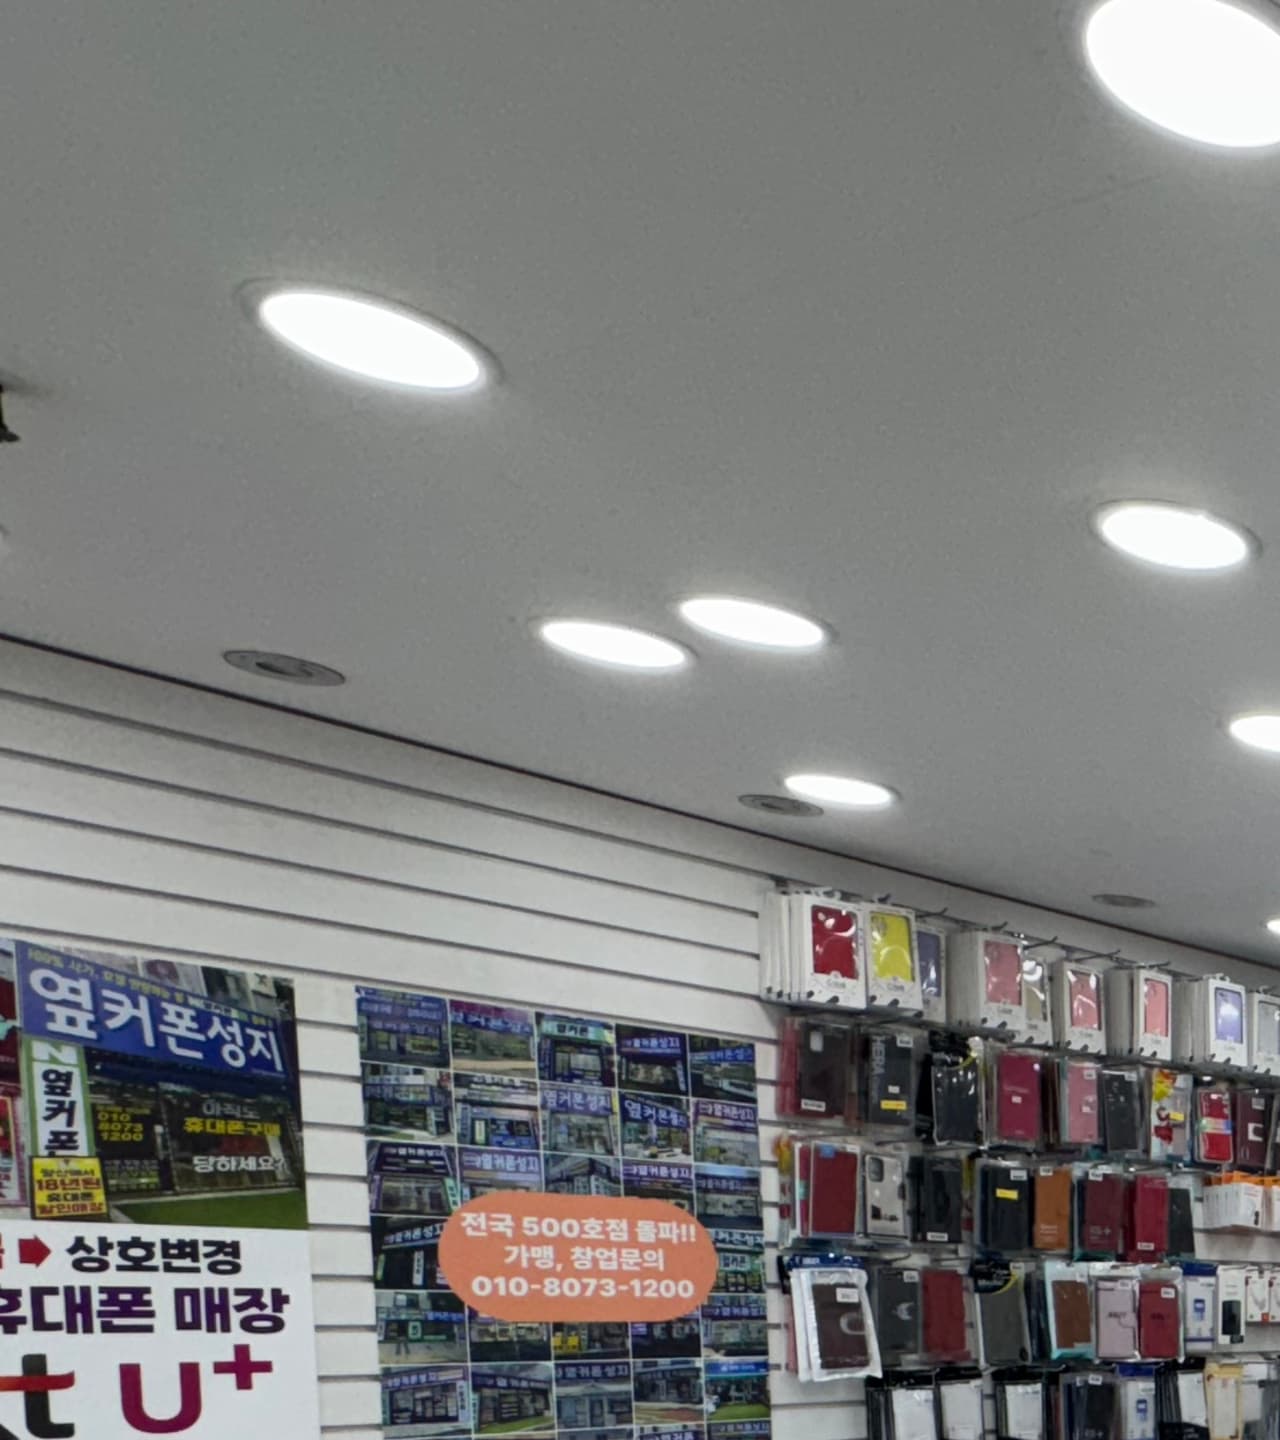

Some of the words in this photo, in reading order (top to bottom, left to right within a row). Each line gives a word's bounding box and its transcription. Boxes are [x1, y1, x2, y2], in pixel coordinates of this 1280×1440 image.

[29, 968, 283, 1072] 옆커폰성지
[203, 1102, 260, 1119] 아직도
[193, 1155, 285, 1173] 당하세요?
[461, 1214, 514, 1241] 전국
[522, 1216, 628, 1243] 500호점
[634, 1219, 697, 1245] 돌파!!
[66, 1236, 242, 1275] 상호변경
[504, 1247, 562, 1271] 가맹,
[571, 1248, 665, 1271] 창업문의
[471, 1275, 695, 1299] 010-8073-1200
[174, 1287, 290, 1334] 매장
